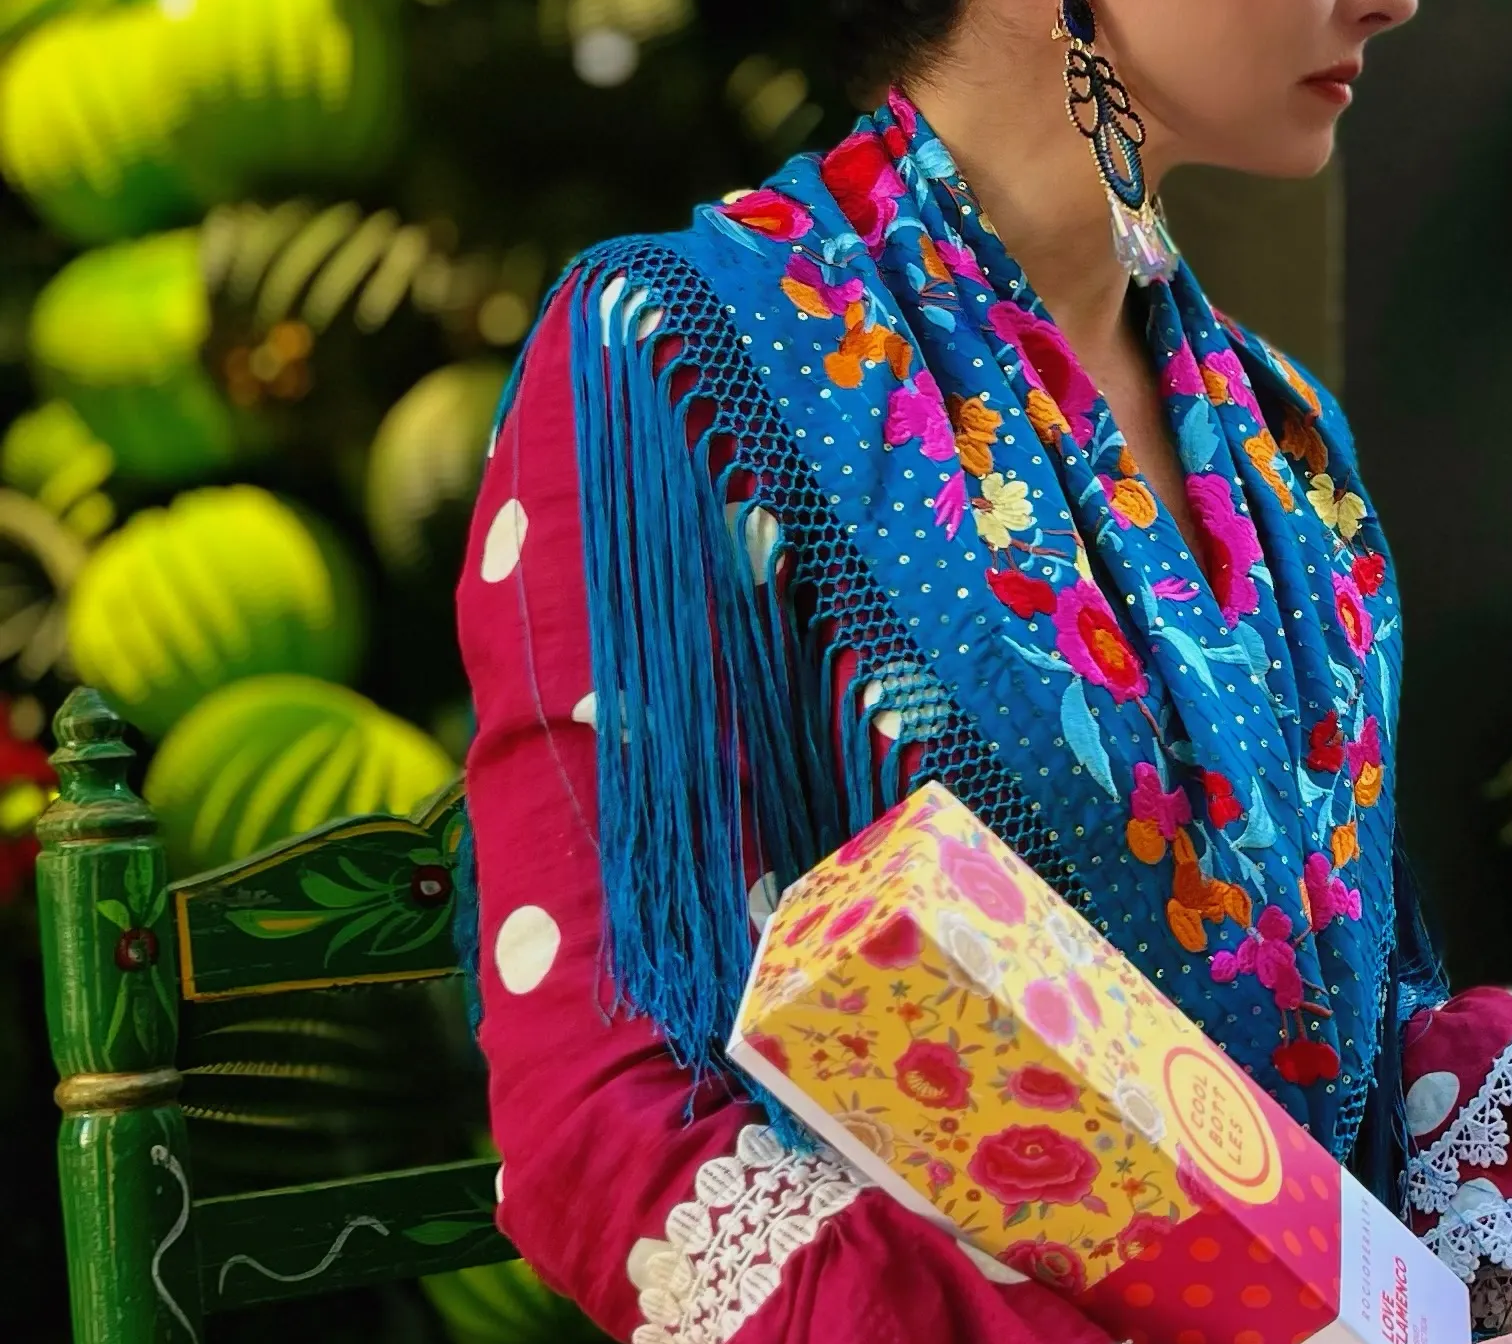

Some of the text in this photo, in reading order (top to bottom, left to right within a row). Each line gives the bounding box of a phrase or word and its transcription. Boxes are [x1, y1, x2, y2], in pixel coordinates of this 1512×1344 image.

[1190, 1075, 1208, 1129] COOL
[1208, 1086, 1226, 1149] BOTT
[1227, 1117, 1243, 1166] LES
[1381, 1289, 1395, 1344] LOVE
